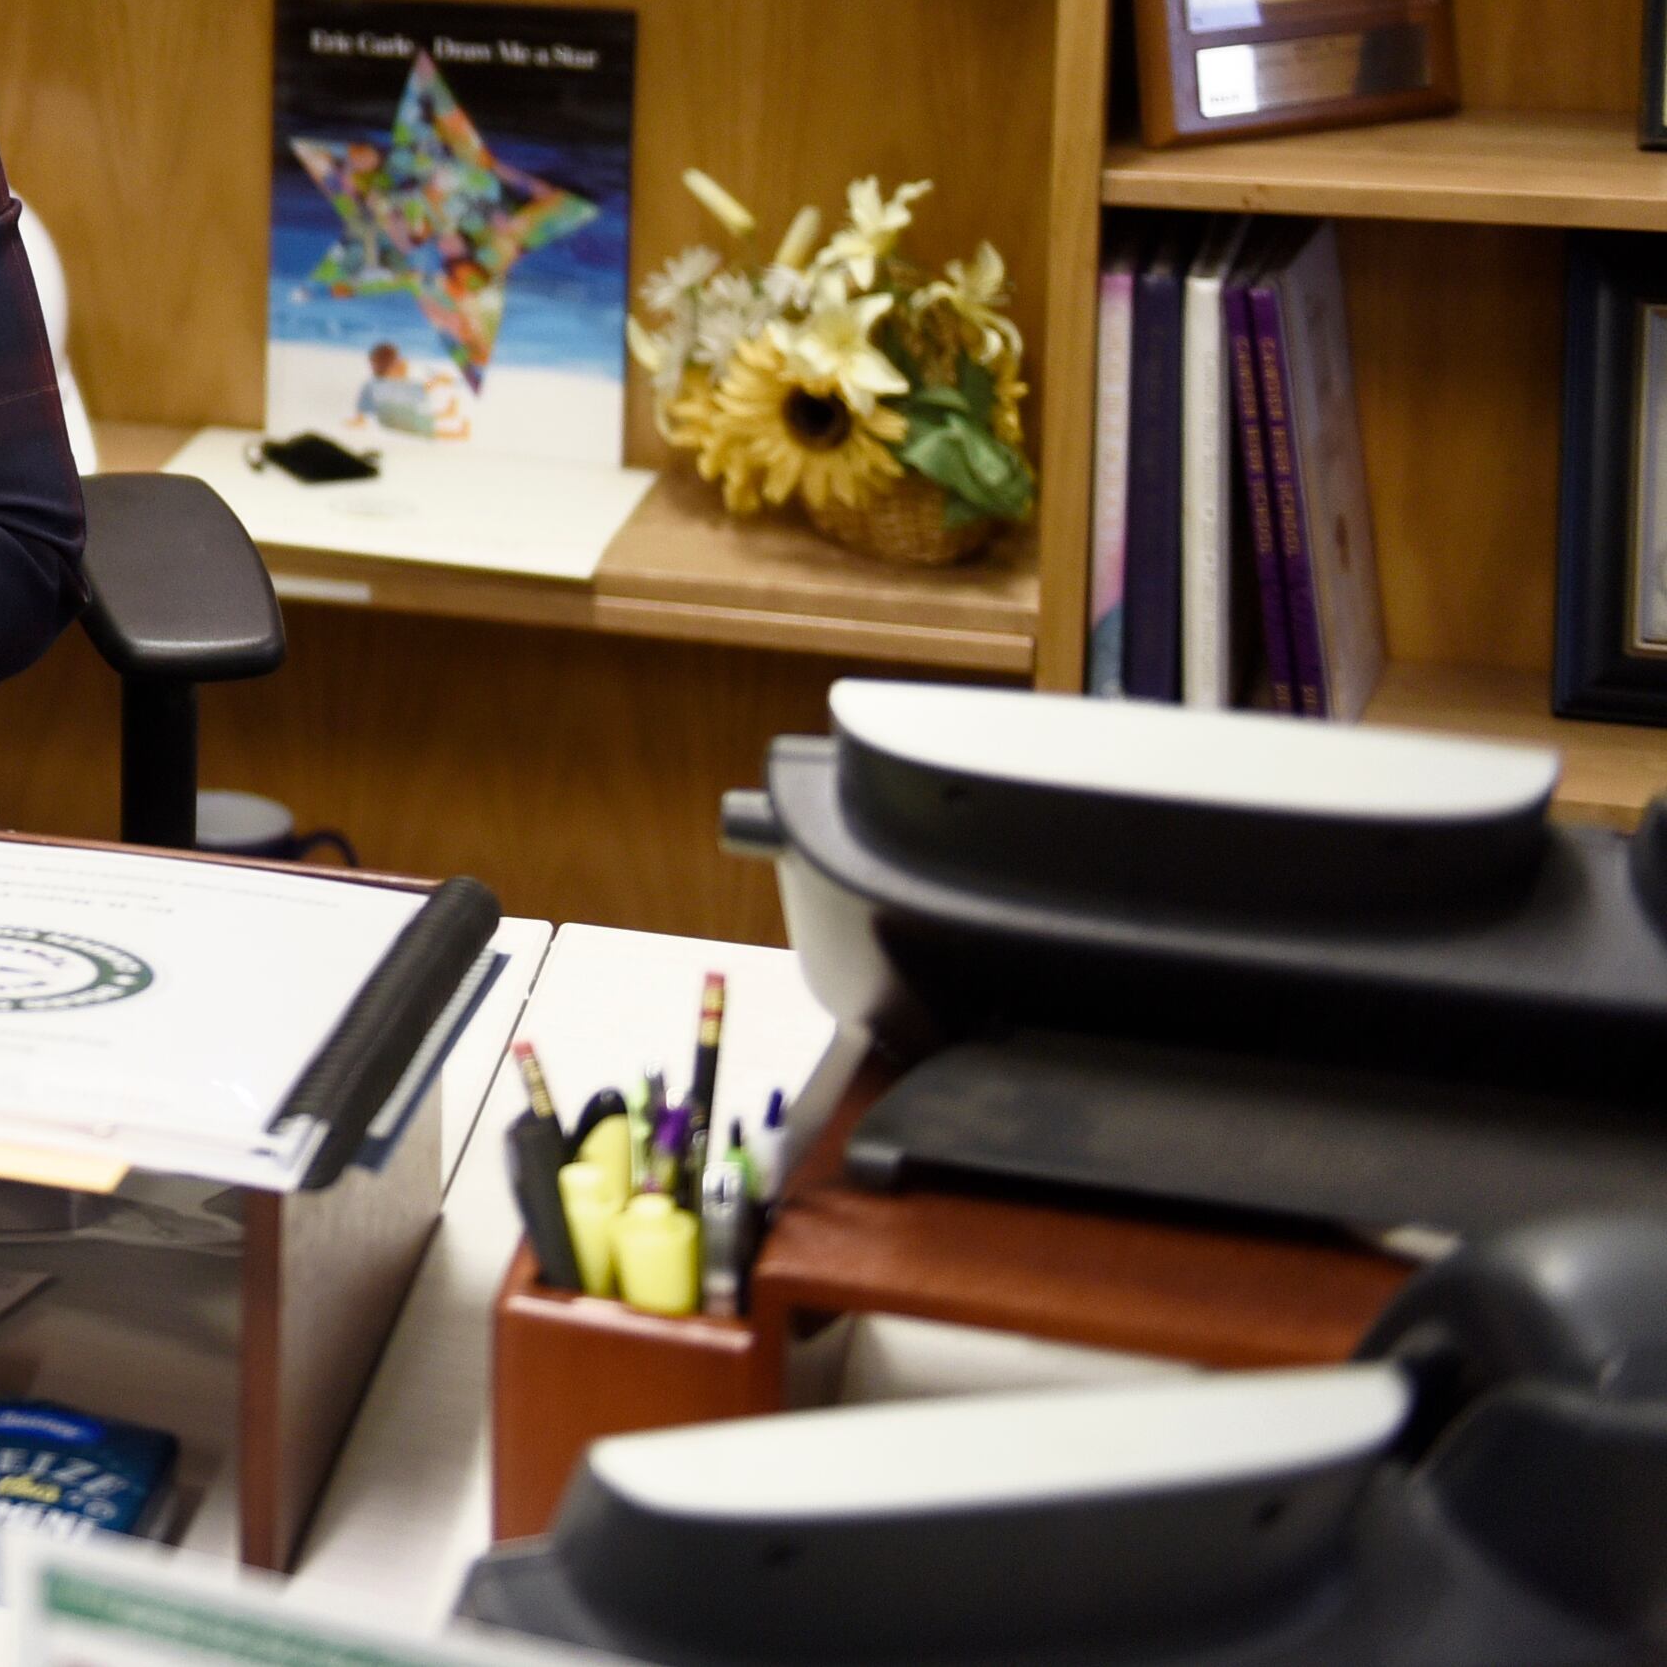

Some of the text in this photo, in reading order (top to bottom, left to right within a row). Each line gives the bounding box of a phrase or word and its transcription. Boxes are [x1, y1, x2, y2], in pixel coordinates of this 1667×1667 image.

[309, 28, 415, 59] Eric Carle
[432, 36, 492, 64] Draw
[497, 39, 530, 65] Me
[550, 42, 598, 70] Star
